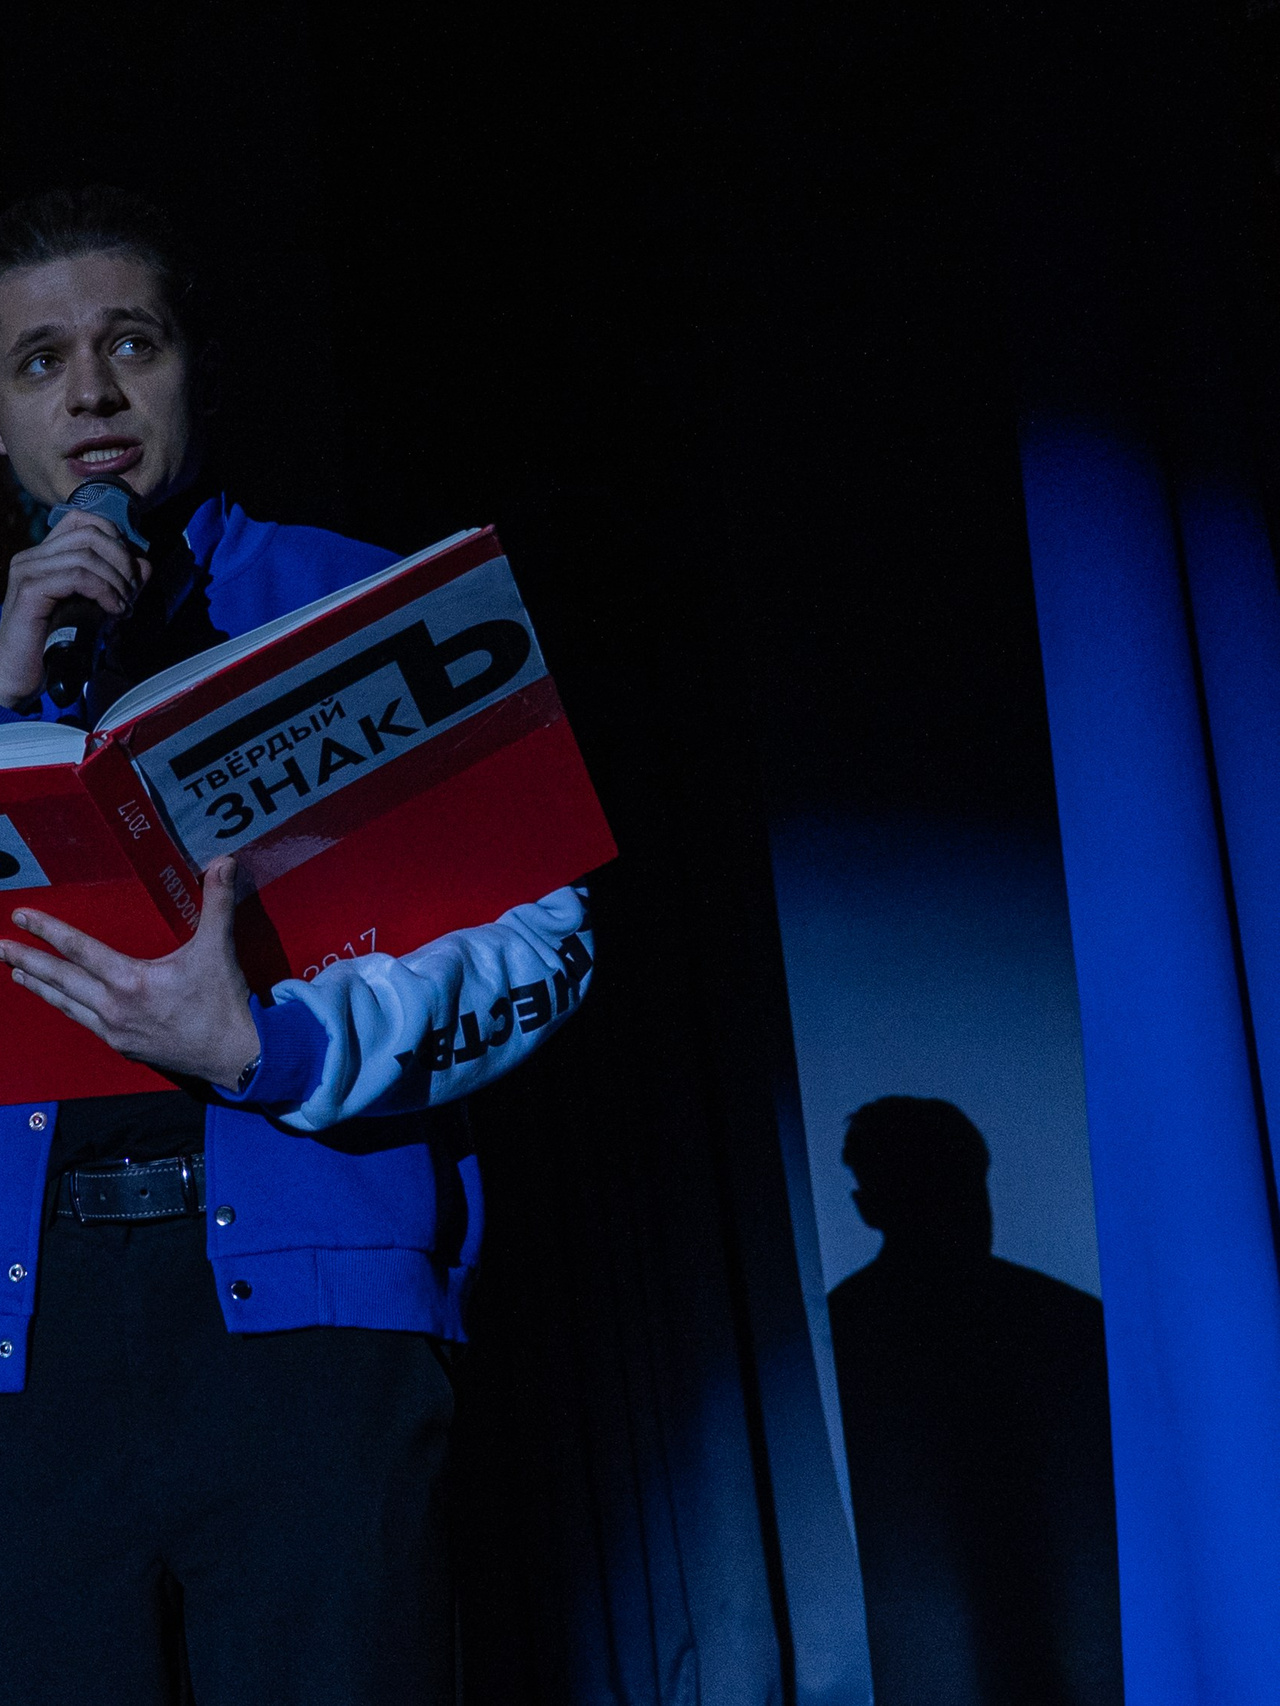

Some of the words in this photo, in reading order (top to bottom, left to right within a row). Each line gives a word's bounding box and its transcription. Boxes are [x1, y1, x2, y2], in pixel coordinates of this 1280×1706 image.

[184, 697, 347, 798] ТВЁРДЫЙ
[205, 697, 420, 839] ЗНАК
[117, 799, 151, 840] 2017
[158, 864, 200, 931] МОСКВЫ
